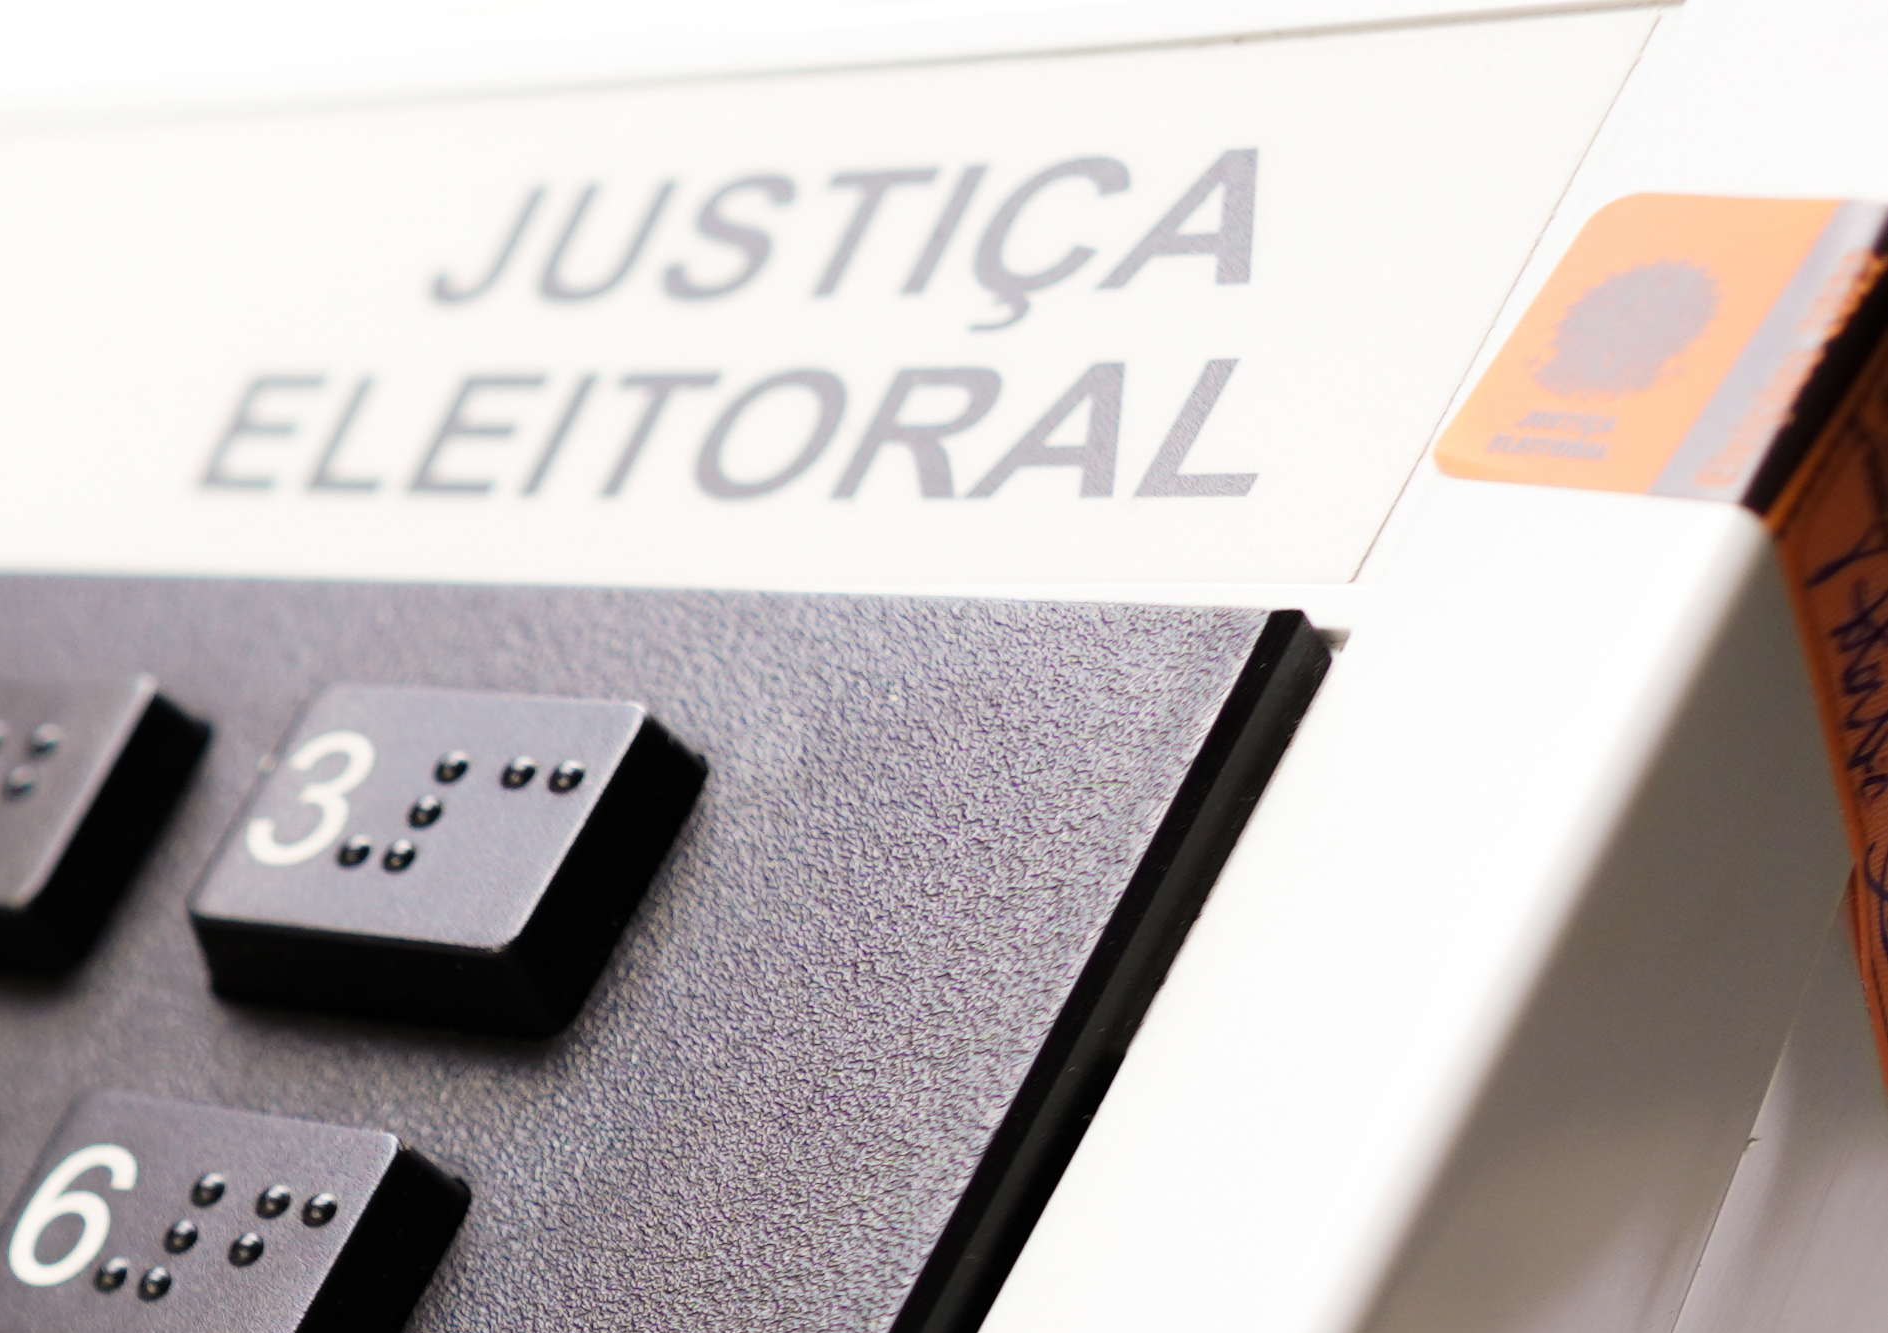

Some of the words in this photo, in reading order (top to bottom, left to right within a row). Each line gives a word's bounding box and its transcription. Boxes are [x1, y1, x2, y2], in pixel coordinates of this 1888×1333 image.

[431, 147, 1259, 330] JUSTIÇA
[200, 357, 1259, 499] ELEITORAL
[245, 733, 376, 866] 3
[6, 1145, 138, 1286] 6
